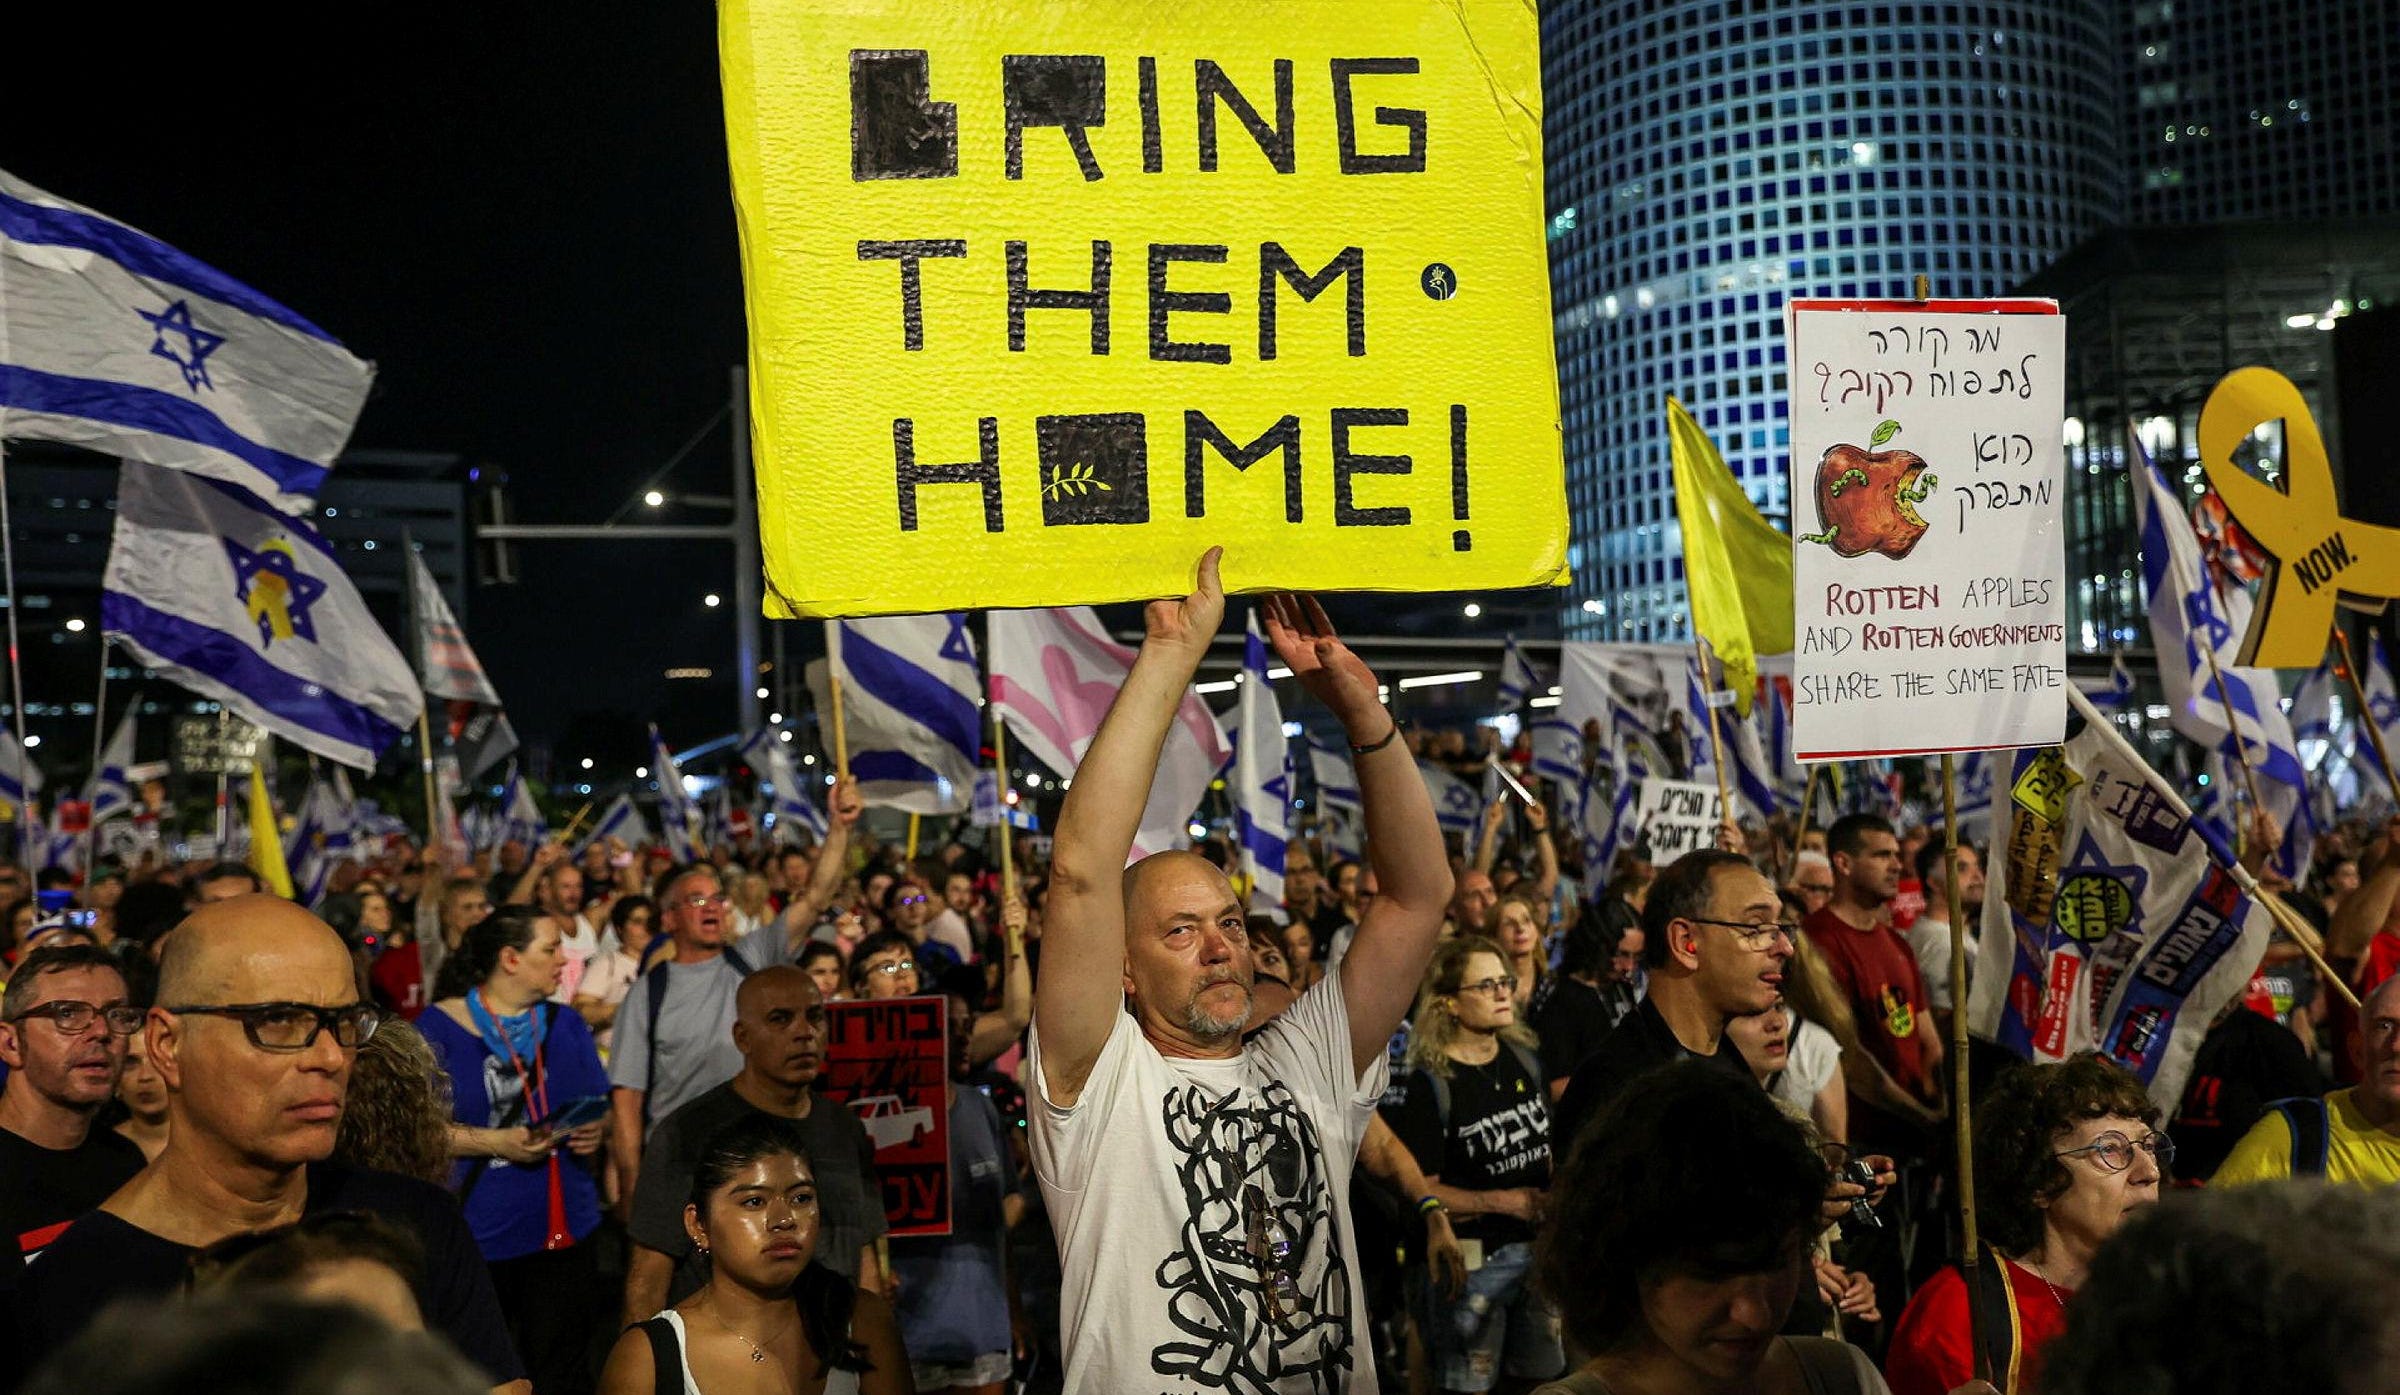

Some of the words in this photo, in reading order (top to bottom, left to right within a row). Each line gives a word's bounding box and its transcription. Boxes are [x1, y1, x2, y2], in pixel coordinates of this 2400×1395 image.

[849, 48, 1427, 183] BRING
[856, 238, 1367, 367] THEM
[1868, 325, 1950, 368] קורה
[1964, 326, 2001, 355] מה
[1813, 361, 1913, 414] רקוב?
[1929, 354, 2037, 400] לתפוח
[1972, 430, 2033, 472] הוא
[893, 404, 1472, 554] HOME!
[1953, 480, 2052, 534] מתפרק
[2291, 531, 2359, 596] NOW.
[1825, 583, 1940, 617] ROTTEN
[1962, 577, 2054, 609] APPLES
[1802, 626, 1853, 657] AND
[1861, 622, 1945, 652] ROTTEN
[1948, 621, 2064, 650] GOVERNMENTS
[1797, 671, 1882, 706] SHARE
[1889, 670, 1935, 698] THE
[1944, 667, 2004, 697] SAME
[2011, 664, 2065, 695] FATE
